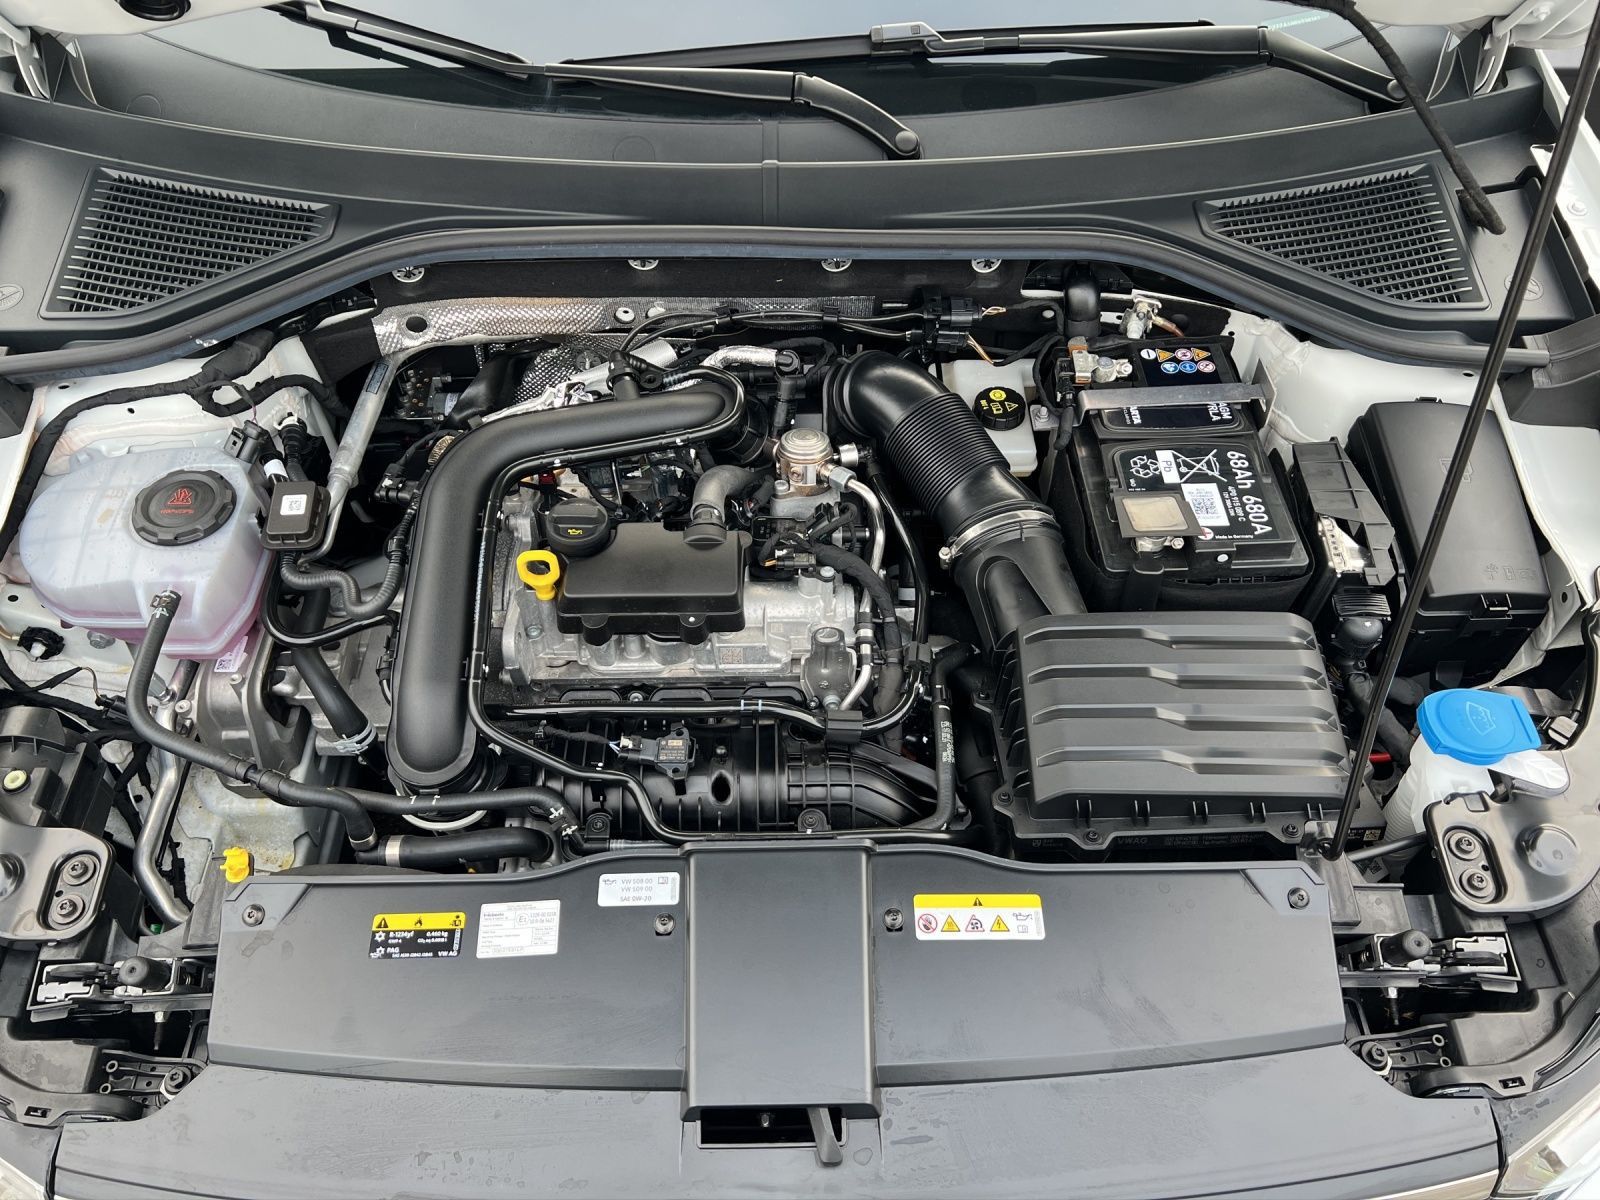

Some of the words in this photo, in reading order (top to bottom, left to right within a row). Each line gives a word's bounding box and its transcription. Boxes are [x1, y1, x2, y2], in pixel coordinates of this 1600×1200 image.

[1130, 405, 1142, 424] ARTA
[1218, 401, 1233, 419] AGM
[1161, 460, 1173, 472] Pb
[1227, 451, 1255, 489] 68Ah
[1242, 494, 1273, 535] 680A
[1232, 496, 1241, 506] 915
